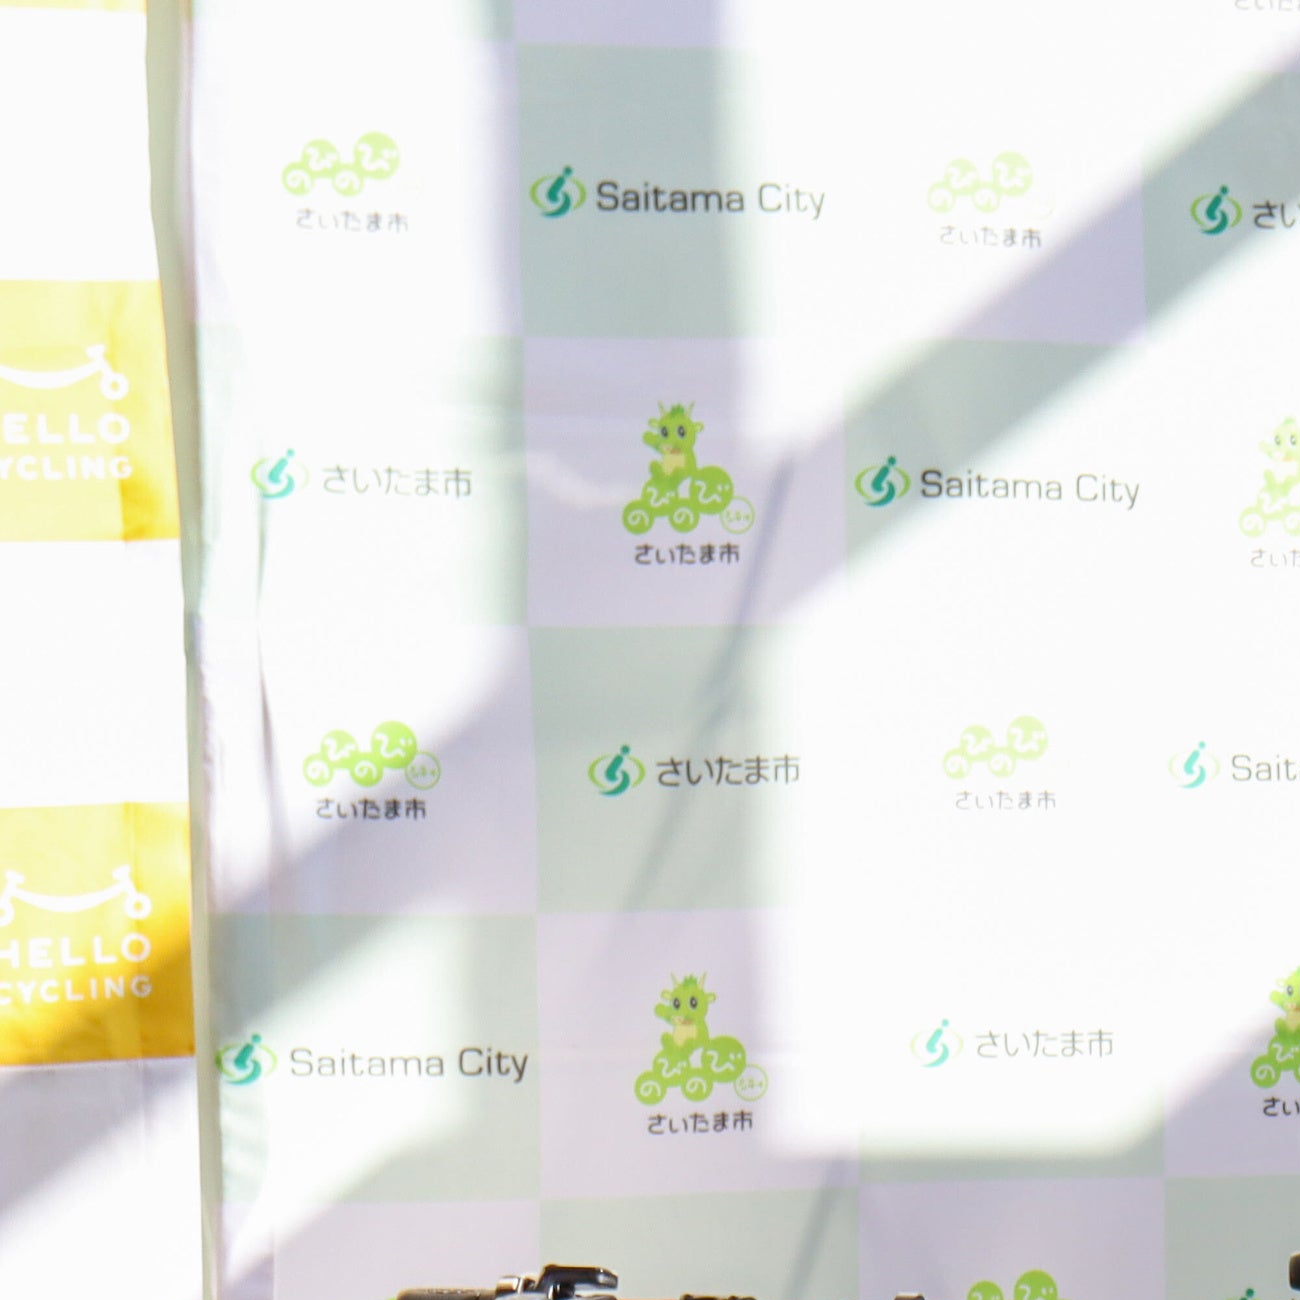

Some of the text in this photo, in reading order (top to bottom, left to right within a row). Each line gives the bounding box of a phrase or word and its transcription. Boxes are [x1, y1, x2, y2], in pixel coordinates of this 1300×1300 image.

[596, 181, 825, 219] Saitama City
[295, 209, 408, 233] さいたま市
[939, 225, 1042, 249] さいたま市
[1, 411, 131, 445] ELLO
[0, 455, 133, 480] YCLING
[322, 464, 472, 498] さいたま市
[626, 477, 731, 527] のびのび
[920, 468, 1141, 509] Saitama City
[634, 543, 740, 565] さいたま市
[307, 733, 414, 780] のびのび
[655, 754, 800, 786] さいたま市
[316, 798, 427, 821] さいたま市
[955, 790, 1057, 810] さいたま市
[974, 1028, 1114, 1058] さいたま市
[290, 1046, 528, 1084] Saitama City
[638, 1047, 743, 1097] のびのび
[647, 1110, 753, 1134] さいたま市
